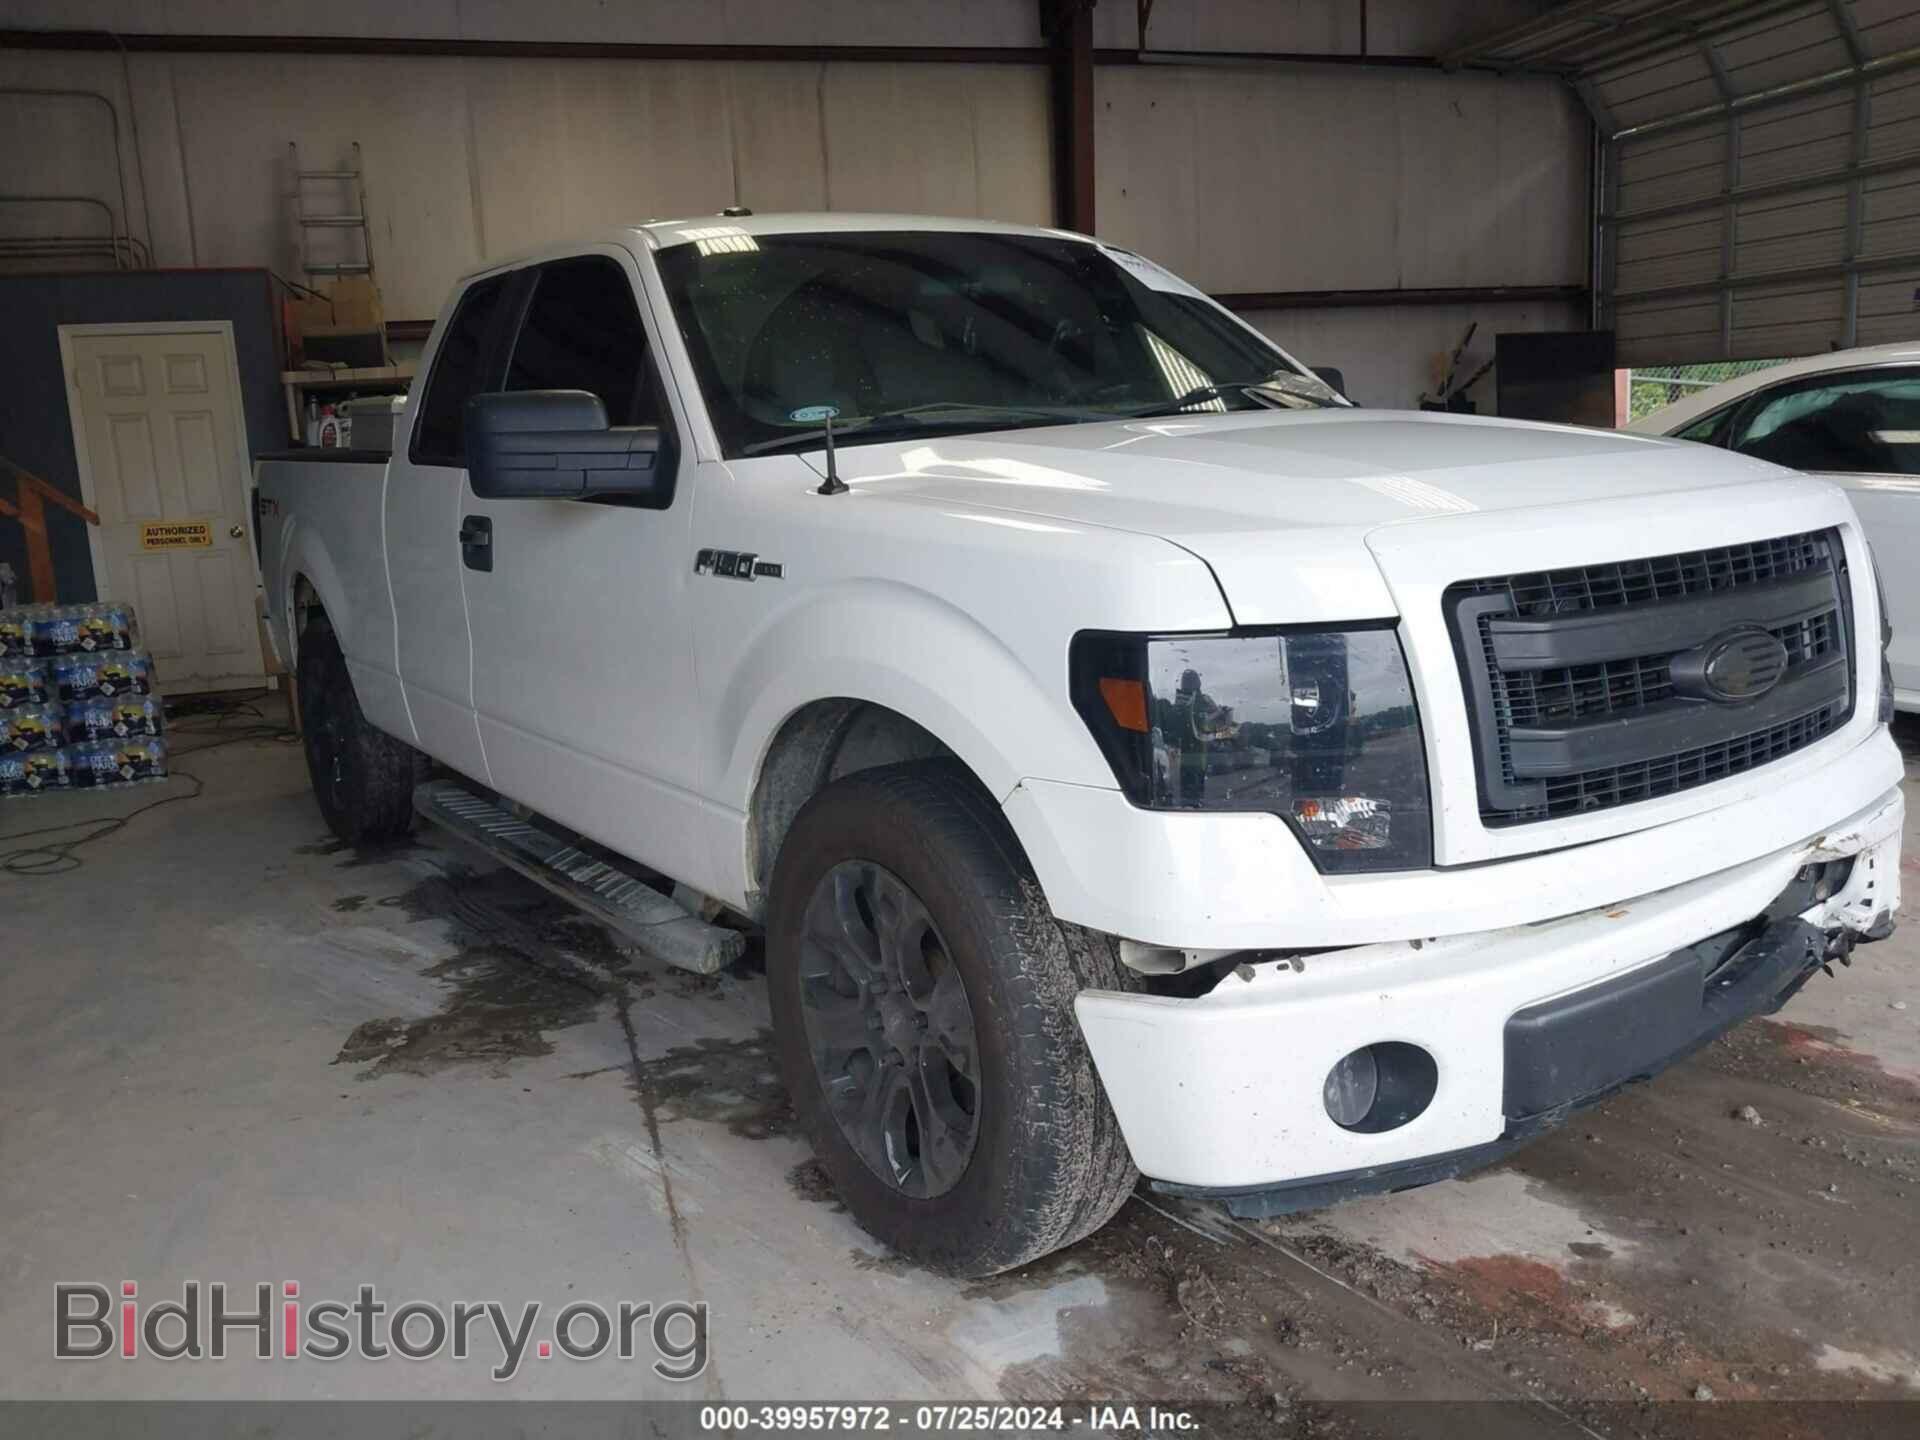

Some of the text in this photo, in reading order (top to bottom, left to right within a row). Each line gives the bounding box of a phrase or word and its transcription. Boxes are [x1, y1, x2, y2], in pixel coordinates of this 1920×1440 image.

[146, 525, 206, 536] AUTHORIZED
[146, 536, 206, 545] PERSONNEL ONLY
